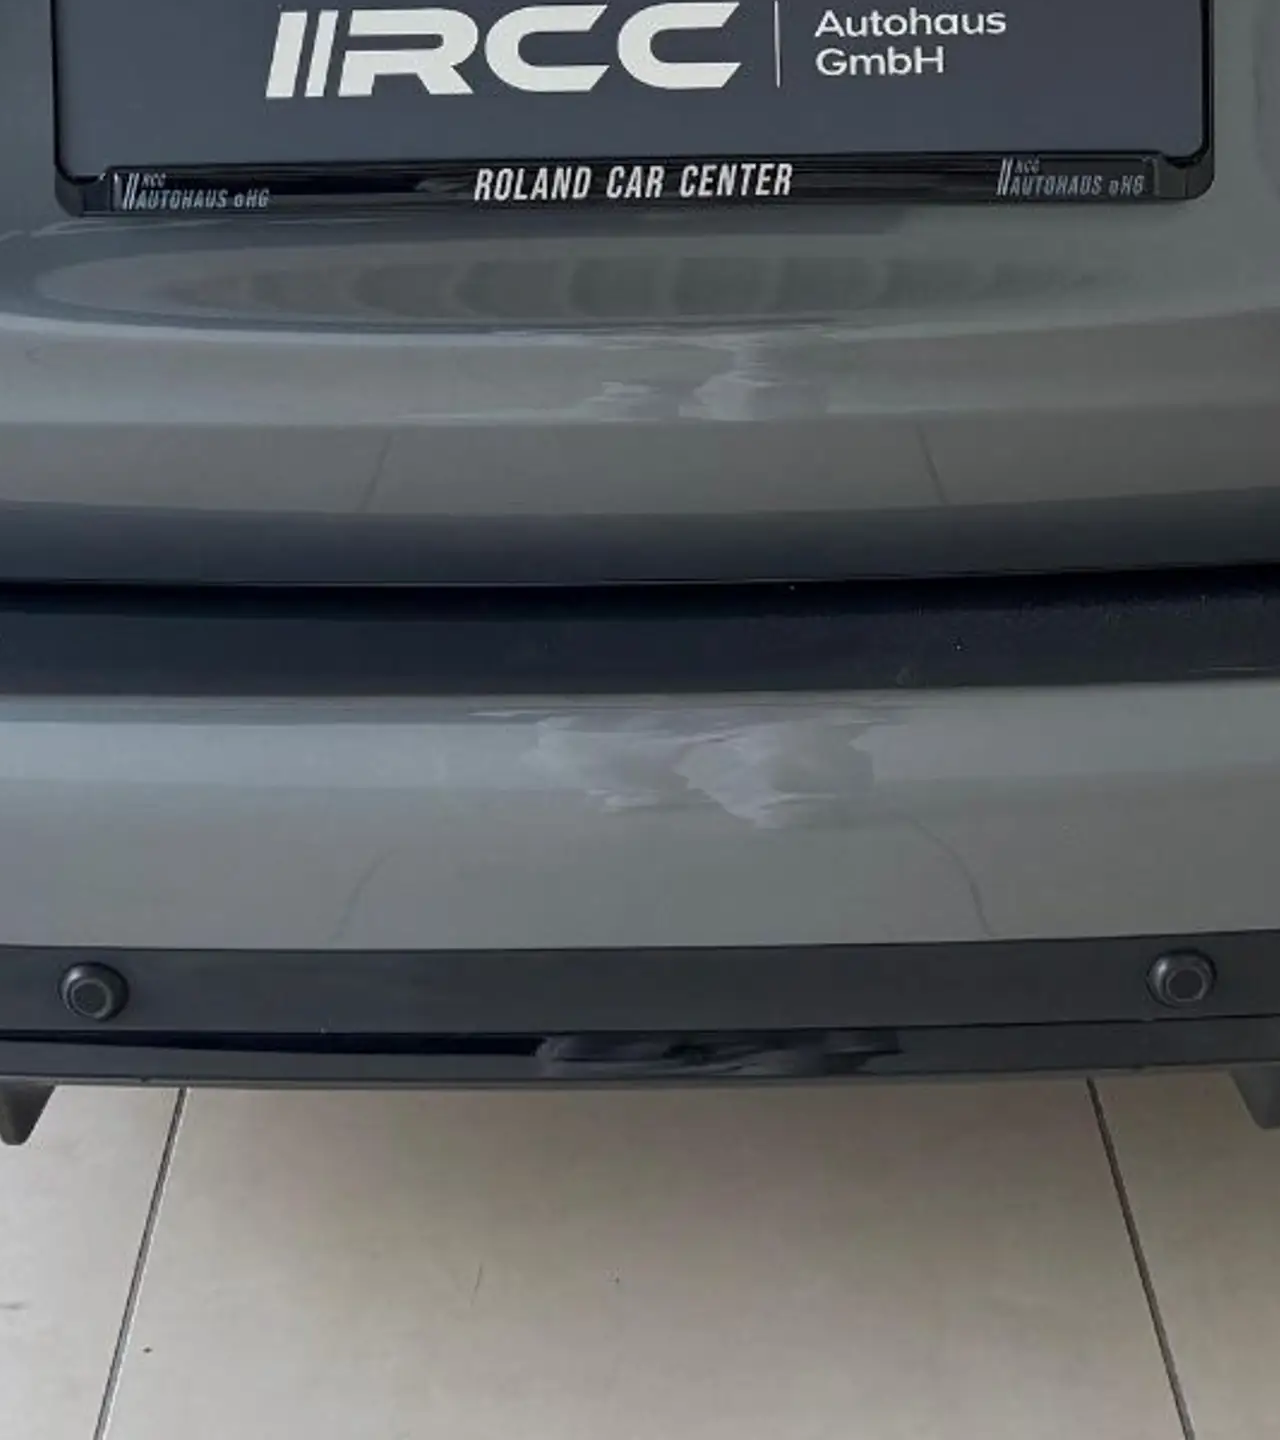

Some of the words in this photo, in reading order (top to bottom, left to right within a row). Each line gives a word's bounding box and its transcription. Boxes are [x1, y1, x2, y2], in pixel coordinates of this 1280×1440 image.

[814, 7, 1008, 38] Autohaus
[815, 45, 945, 76] GmbH
[474, 166, 592, 201] ROLAND
[606, 165, 665, 198] CAR
[679, 162, 793, 197] CENTER
[135, 189, 229, 209] AUTOHAUS
